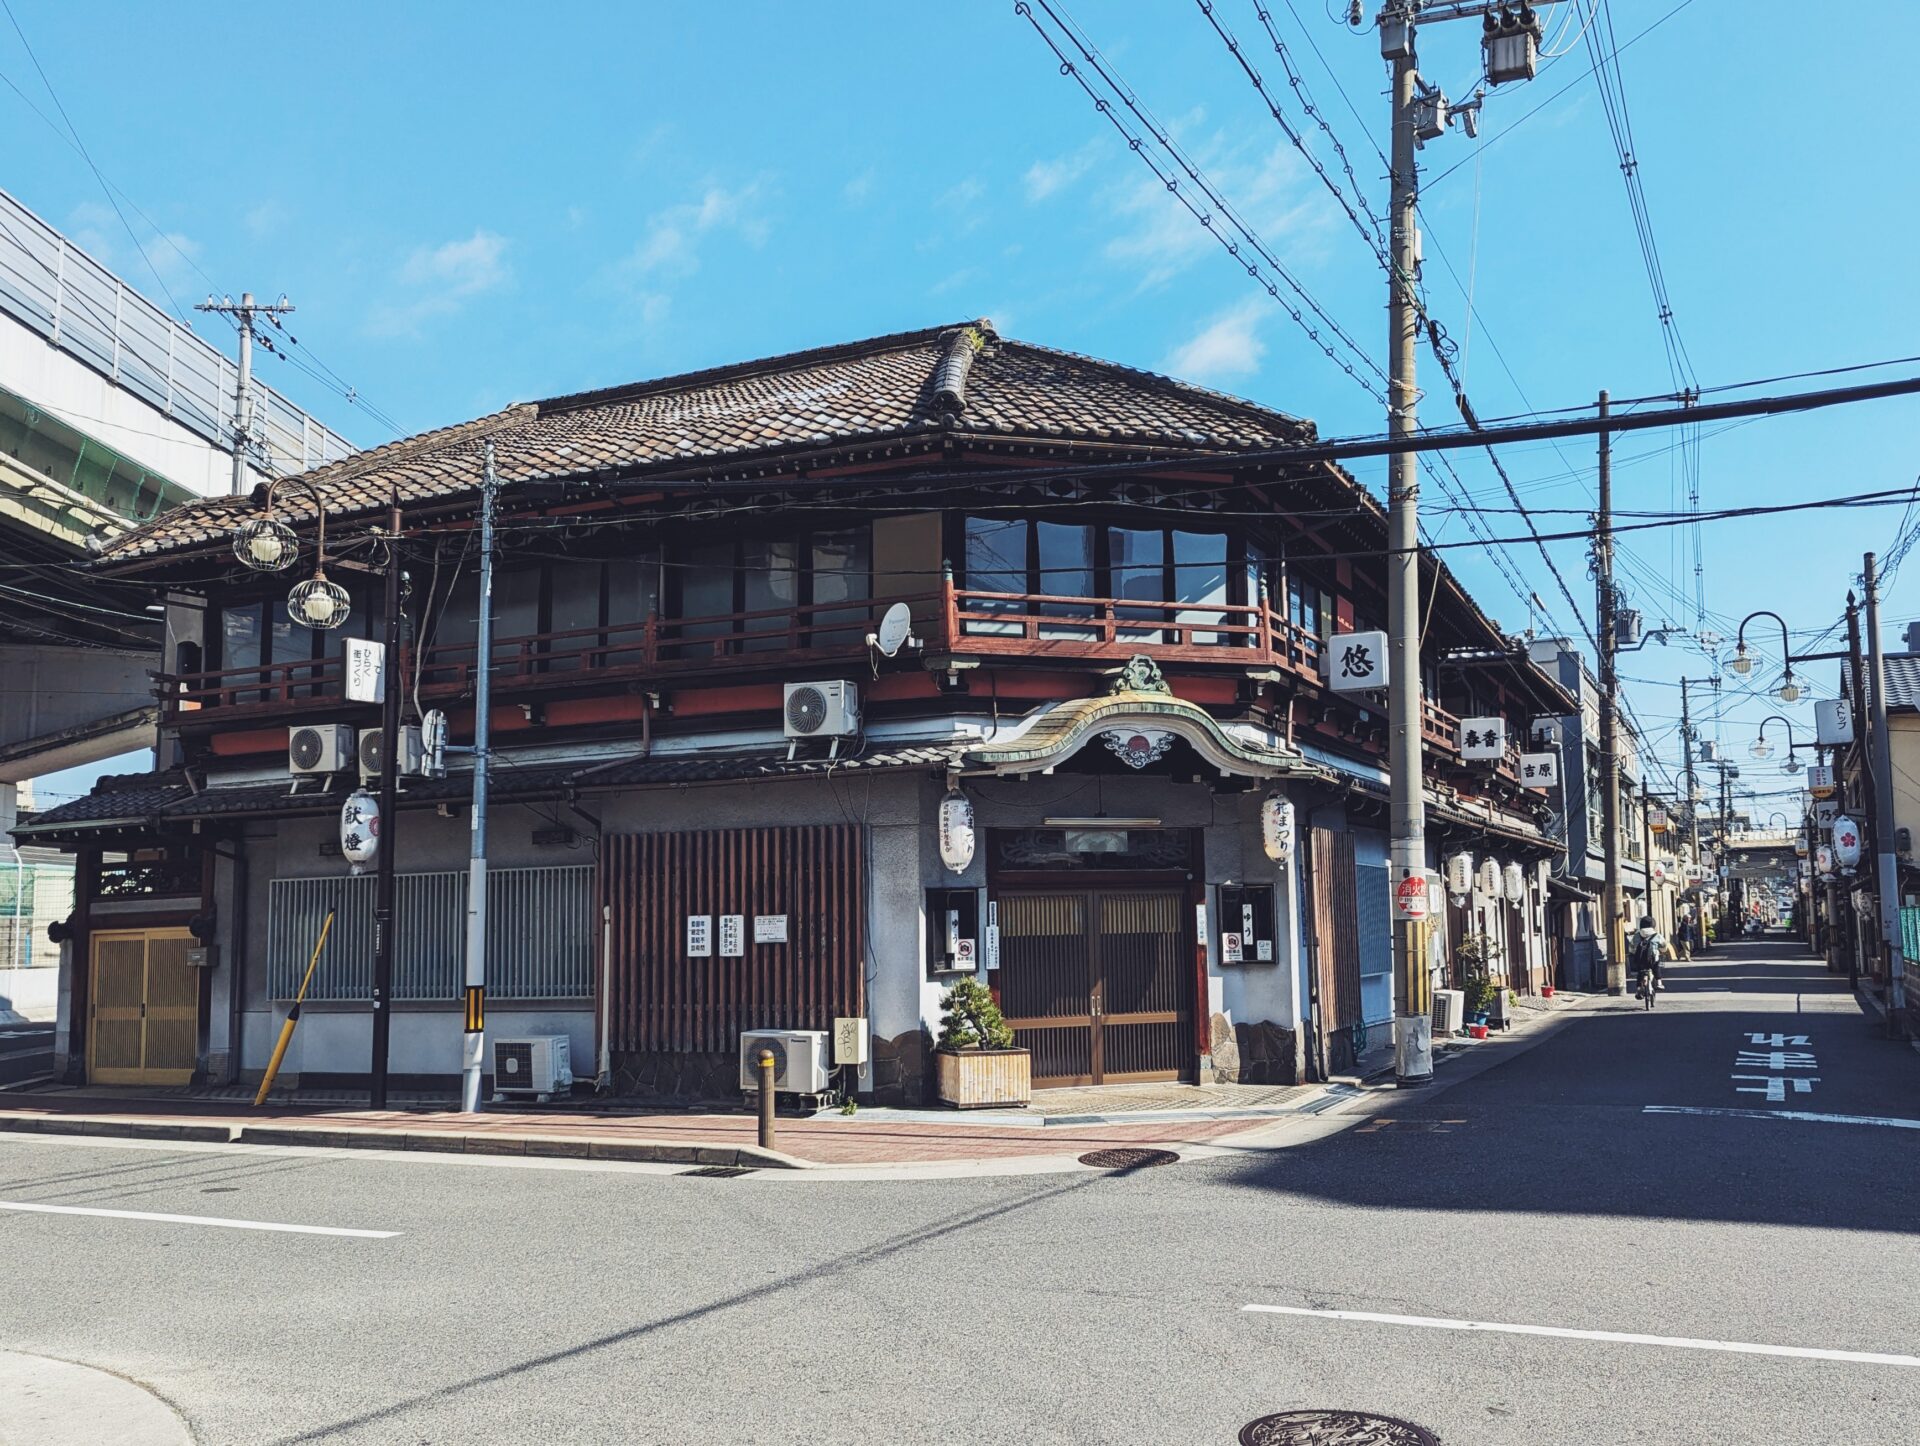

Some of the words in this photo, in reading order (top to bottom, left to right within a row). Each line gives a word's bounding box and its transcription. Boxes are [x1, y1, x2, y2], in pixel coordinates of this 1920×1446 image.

[353, 649, 362, 687] 街づくり
[1340, 644, 1375, 678] 悠
[1836, 702, 1847, 730] ストップ
[1464, 729, 1500, 748] 春香
[1523, 763, 1552, 778] 吉原
[345, 805, 363, 851] 献燈
[964, 803, 974, 853] 花まつり
[1275, 802, 1290, 852] 花まつり
[1243, 913, 1251, 937] ゆう
[1730, 1032, 1821, 1102] 止まれ
